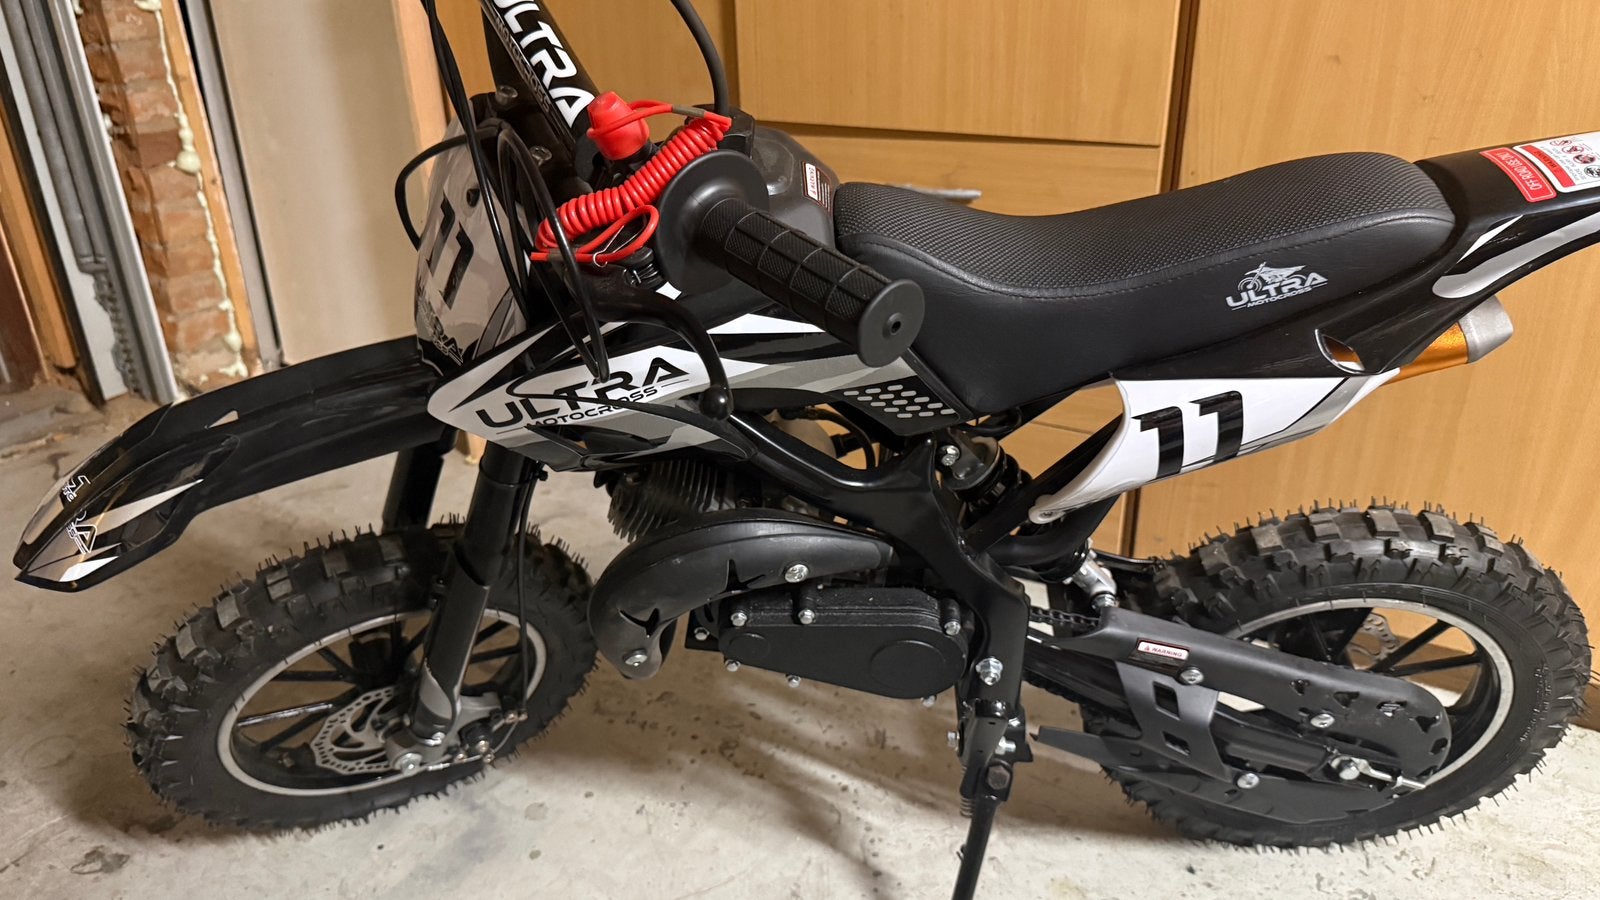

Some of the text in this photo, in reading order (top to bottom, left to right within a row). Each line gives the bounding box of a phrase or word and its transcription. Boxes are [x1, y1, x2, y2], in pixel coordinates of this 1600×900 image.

[1525, 179, 1543, 190] OFF
[1225, 272, 1328, 307] ULTRA
[1247, 286, 1312, 308] MOTOCROSS
[475, 357, 690, 428] ULTRA
[1131, 390, 1244, 480] 11
[1151, 647, 1183, 657] WARNING
